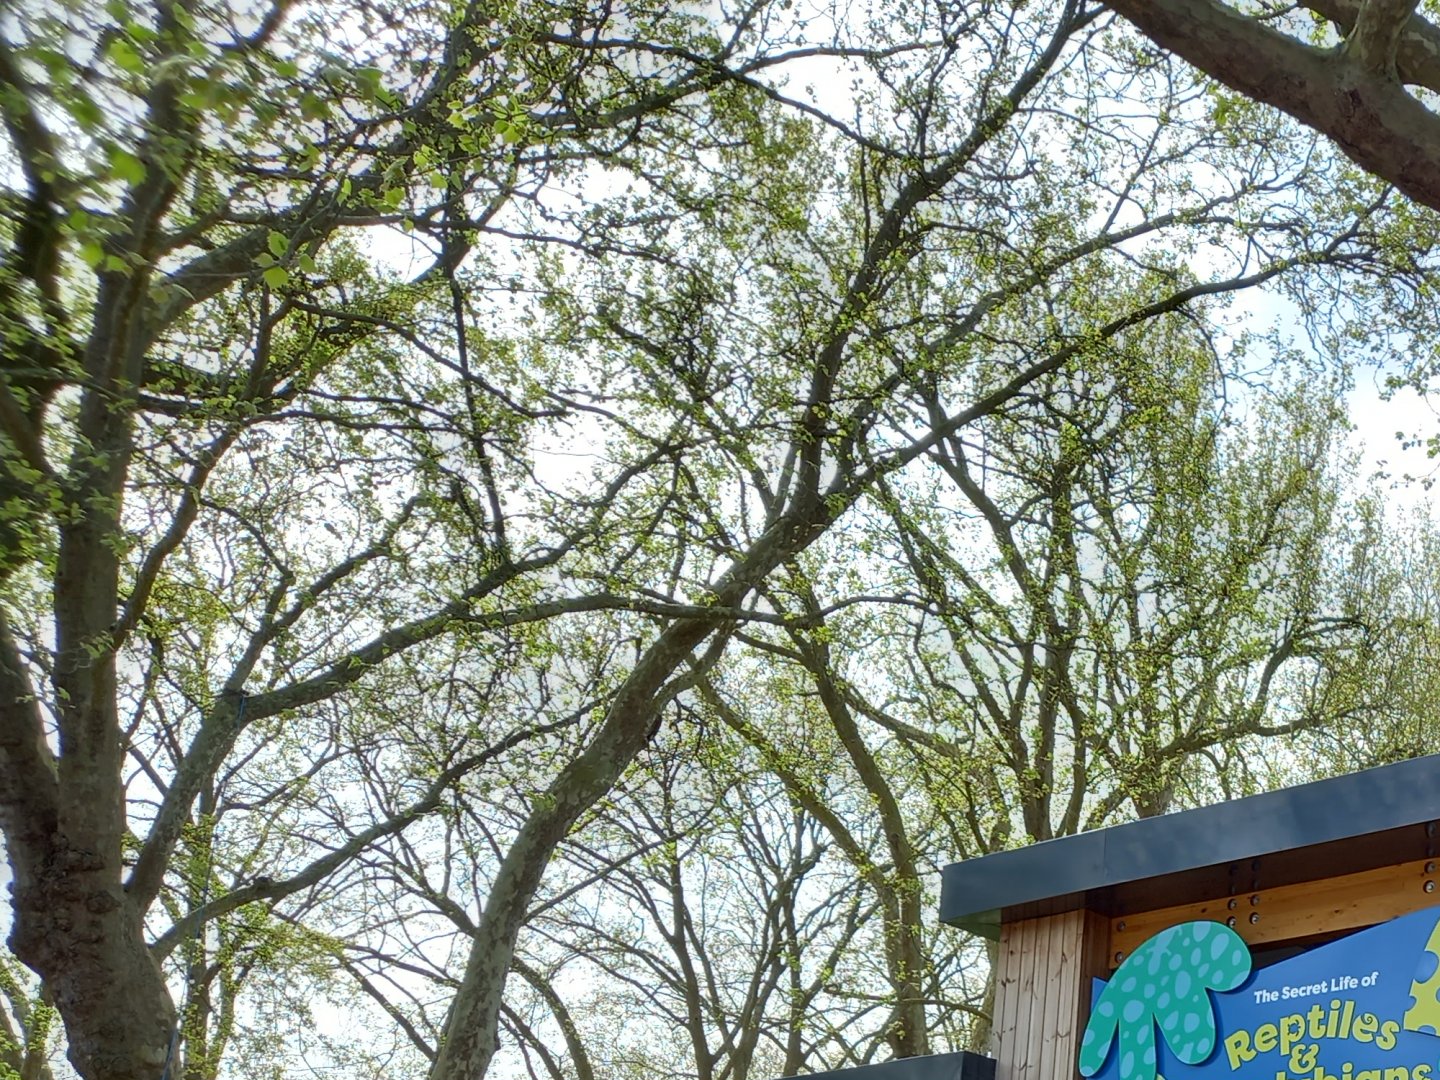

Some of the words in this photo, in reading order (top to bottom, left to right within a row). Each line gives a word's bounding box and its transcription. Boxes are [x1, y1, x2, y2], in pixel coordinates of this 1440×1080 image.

[1254, 989, 1279, 1004] The
[1281, 979, 1328, 1000] Secret
[1330, 974, 1359, 993] Life
[1361, 971, 1379, 989] of
[1223, 999, 1400, 1071] Reptiles
[1288, 1043, 1319, 1074] &
